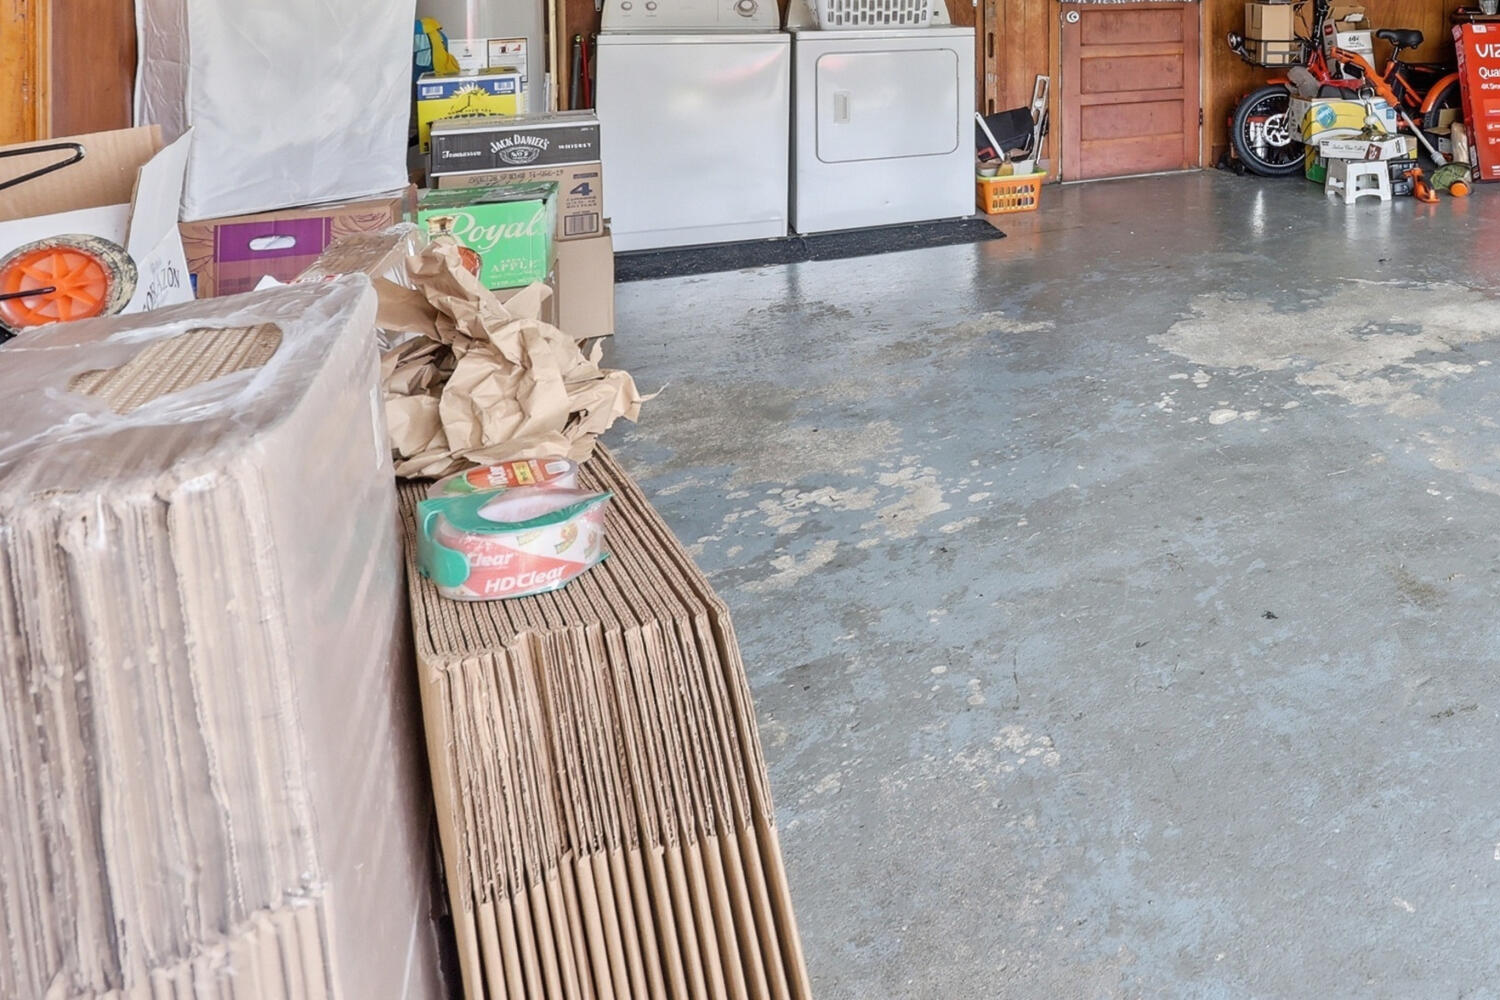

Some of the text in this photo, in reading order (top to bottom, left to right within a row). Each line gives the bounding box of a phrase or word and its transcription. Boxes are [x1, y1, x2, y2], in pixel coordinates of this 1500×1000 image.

[490, 134, 550, 154] JACK DANIEL'S
[570, 182, 593, 196] 4
[449, 206, 548, 256] Royal
[490, 261, 537, 273] APPLE
[469, 552, 514, 567] Clear
